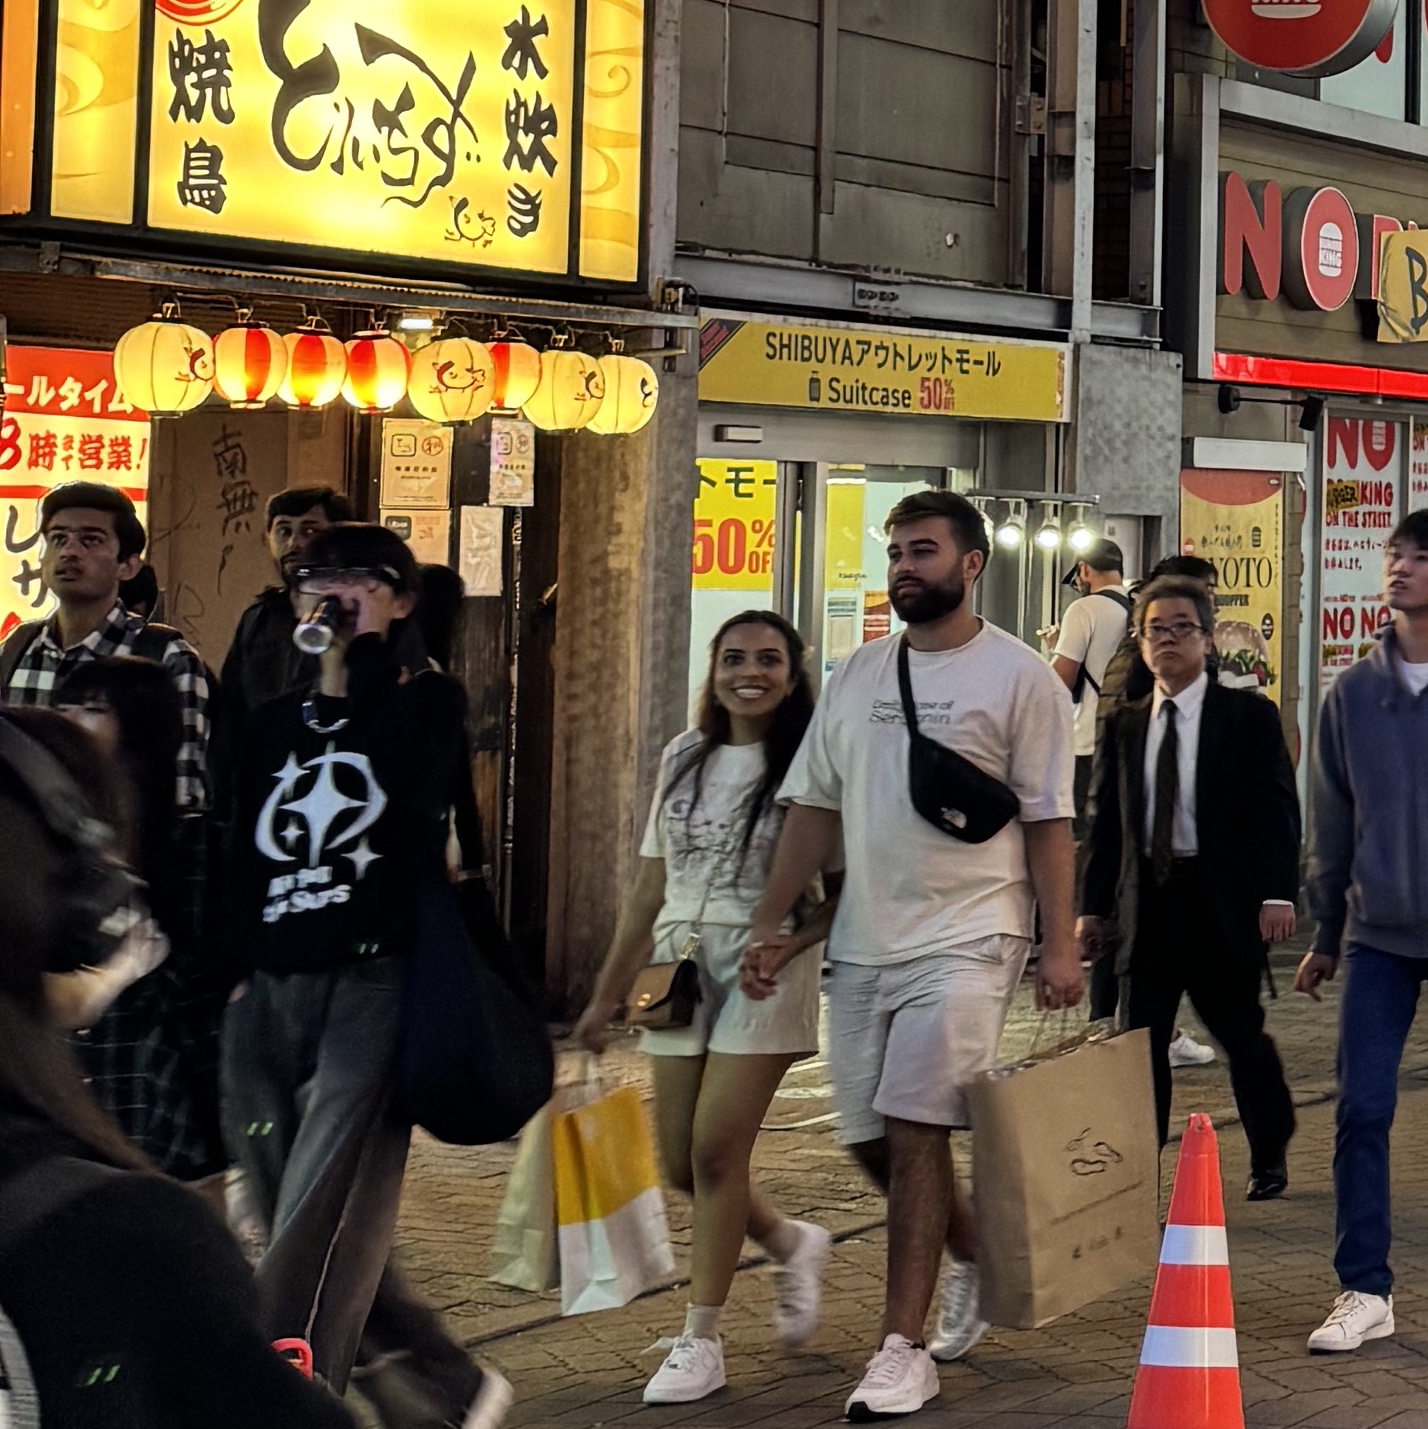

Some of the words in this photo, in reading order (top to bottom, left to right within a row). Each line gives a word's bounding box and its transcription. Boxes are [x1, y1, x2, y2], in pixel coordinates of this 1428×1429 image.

[168, 27, 235, 215] 焼鳥
[1223, 172, 1360, 312] NO
[766, 331, 1002, 378] SHIBUYAアウトレットモール
[828, 377, 913, 410] Suitcase
